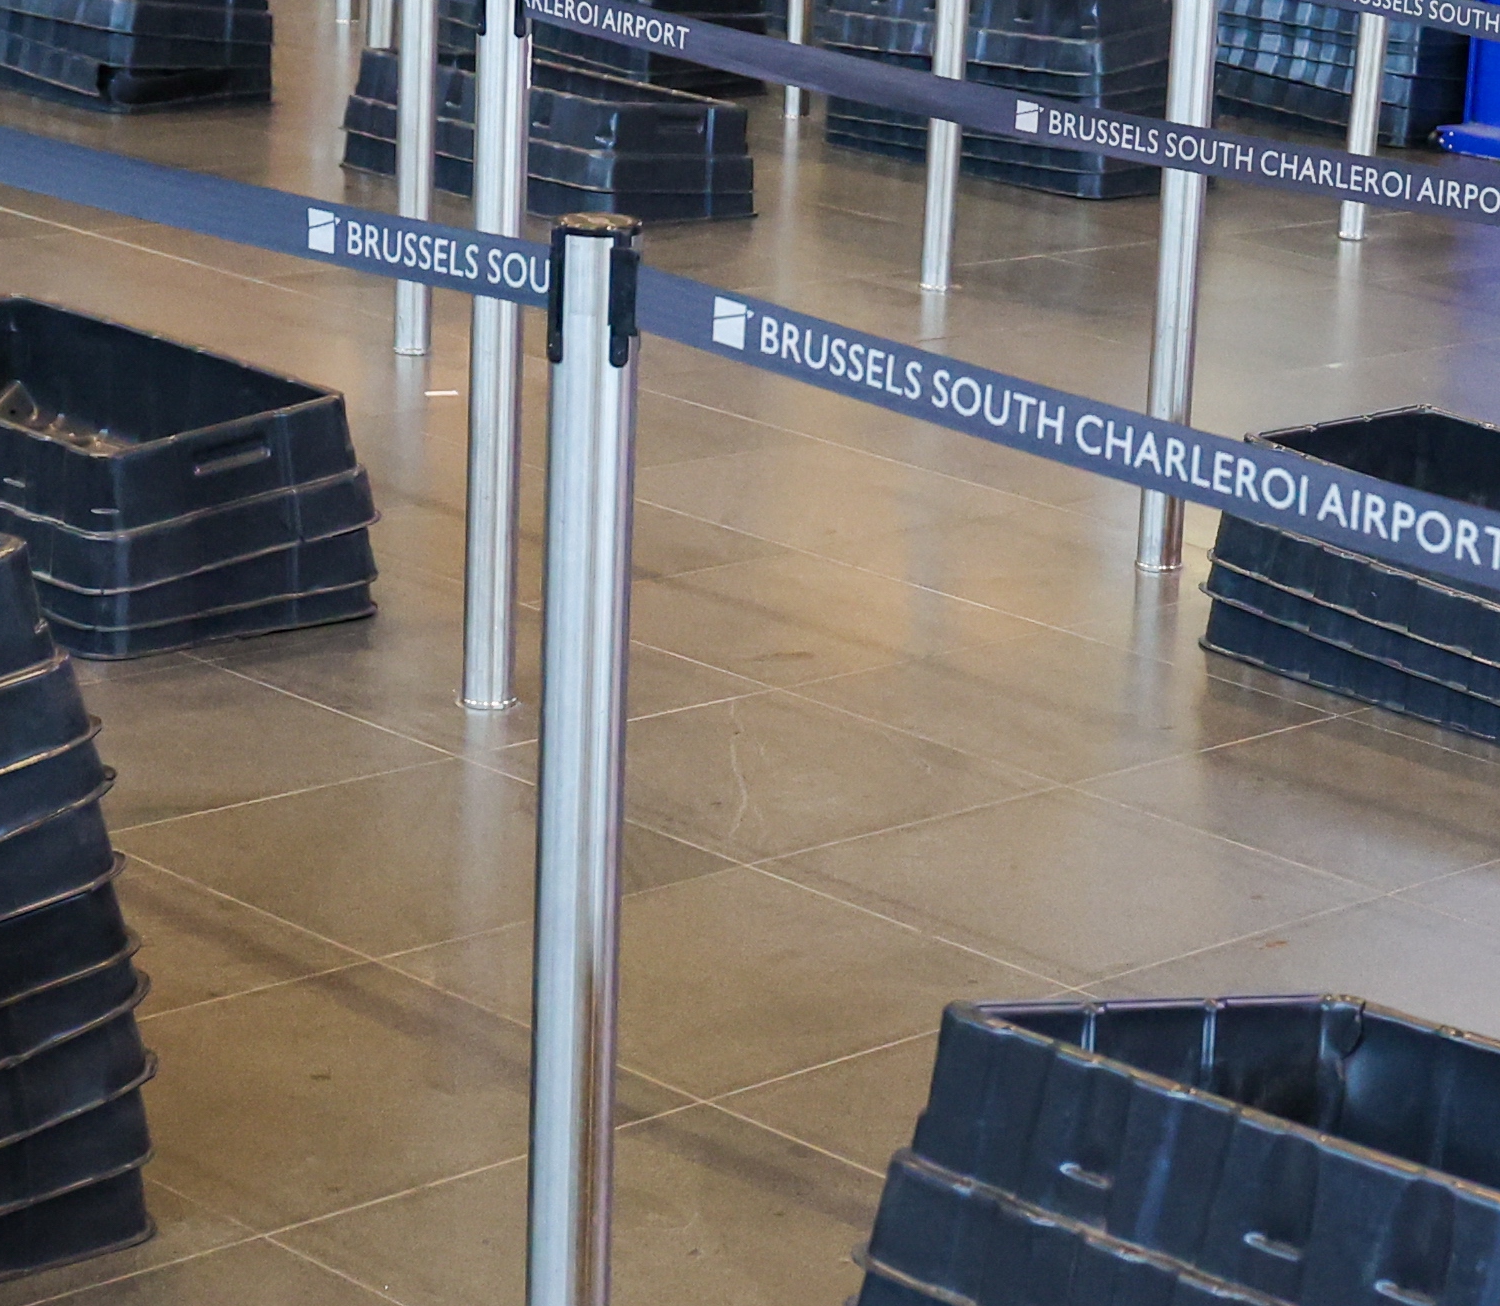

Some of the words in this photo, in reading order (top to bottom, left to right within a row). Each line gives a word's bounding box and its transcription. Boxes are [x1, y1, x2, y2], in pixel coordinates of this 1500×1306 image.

[1048, 110, 1158, 156] BRUSSELS
[1166, 132, 1253, 173] SOUTH
[1261, 150, 1412, 200] CHARLEROI
[347, 223, 478, 279] BRUSSELS
[487, 245, 549, 294] SOU
[760, 315, 921, 400] BRUSSELS
[932, 367, 1065, 444] SOUTH
[1076, 412, 1308, 516] CHARLEROI
